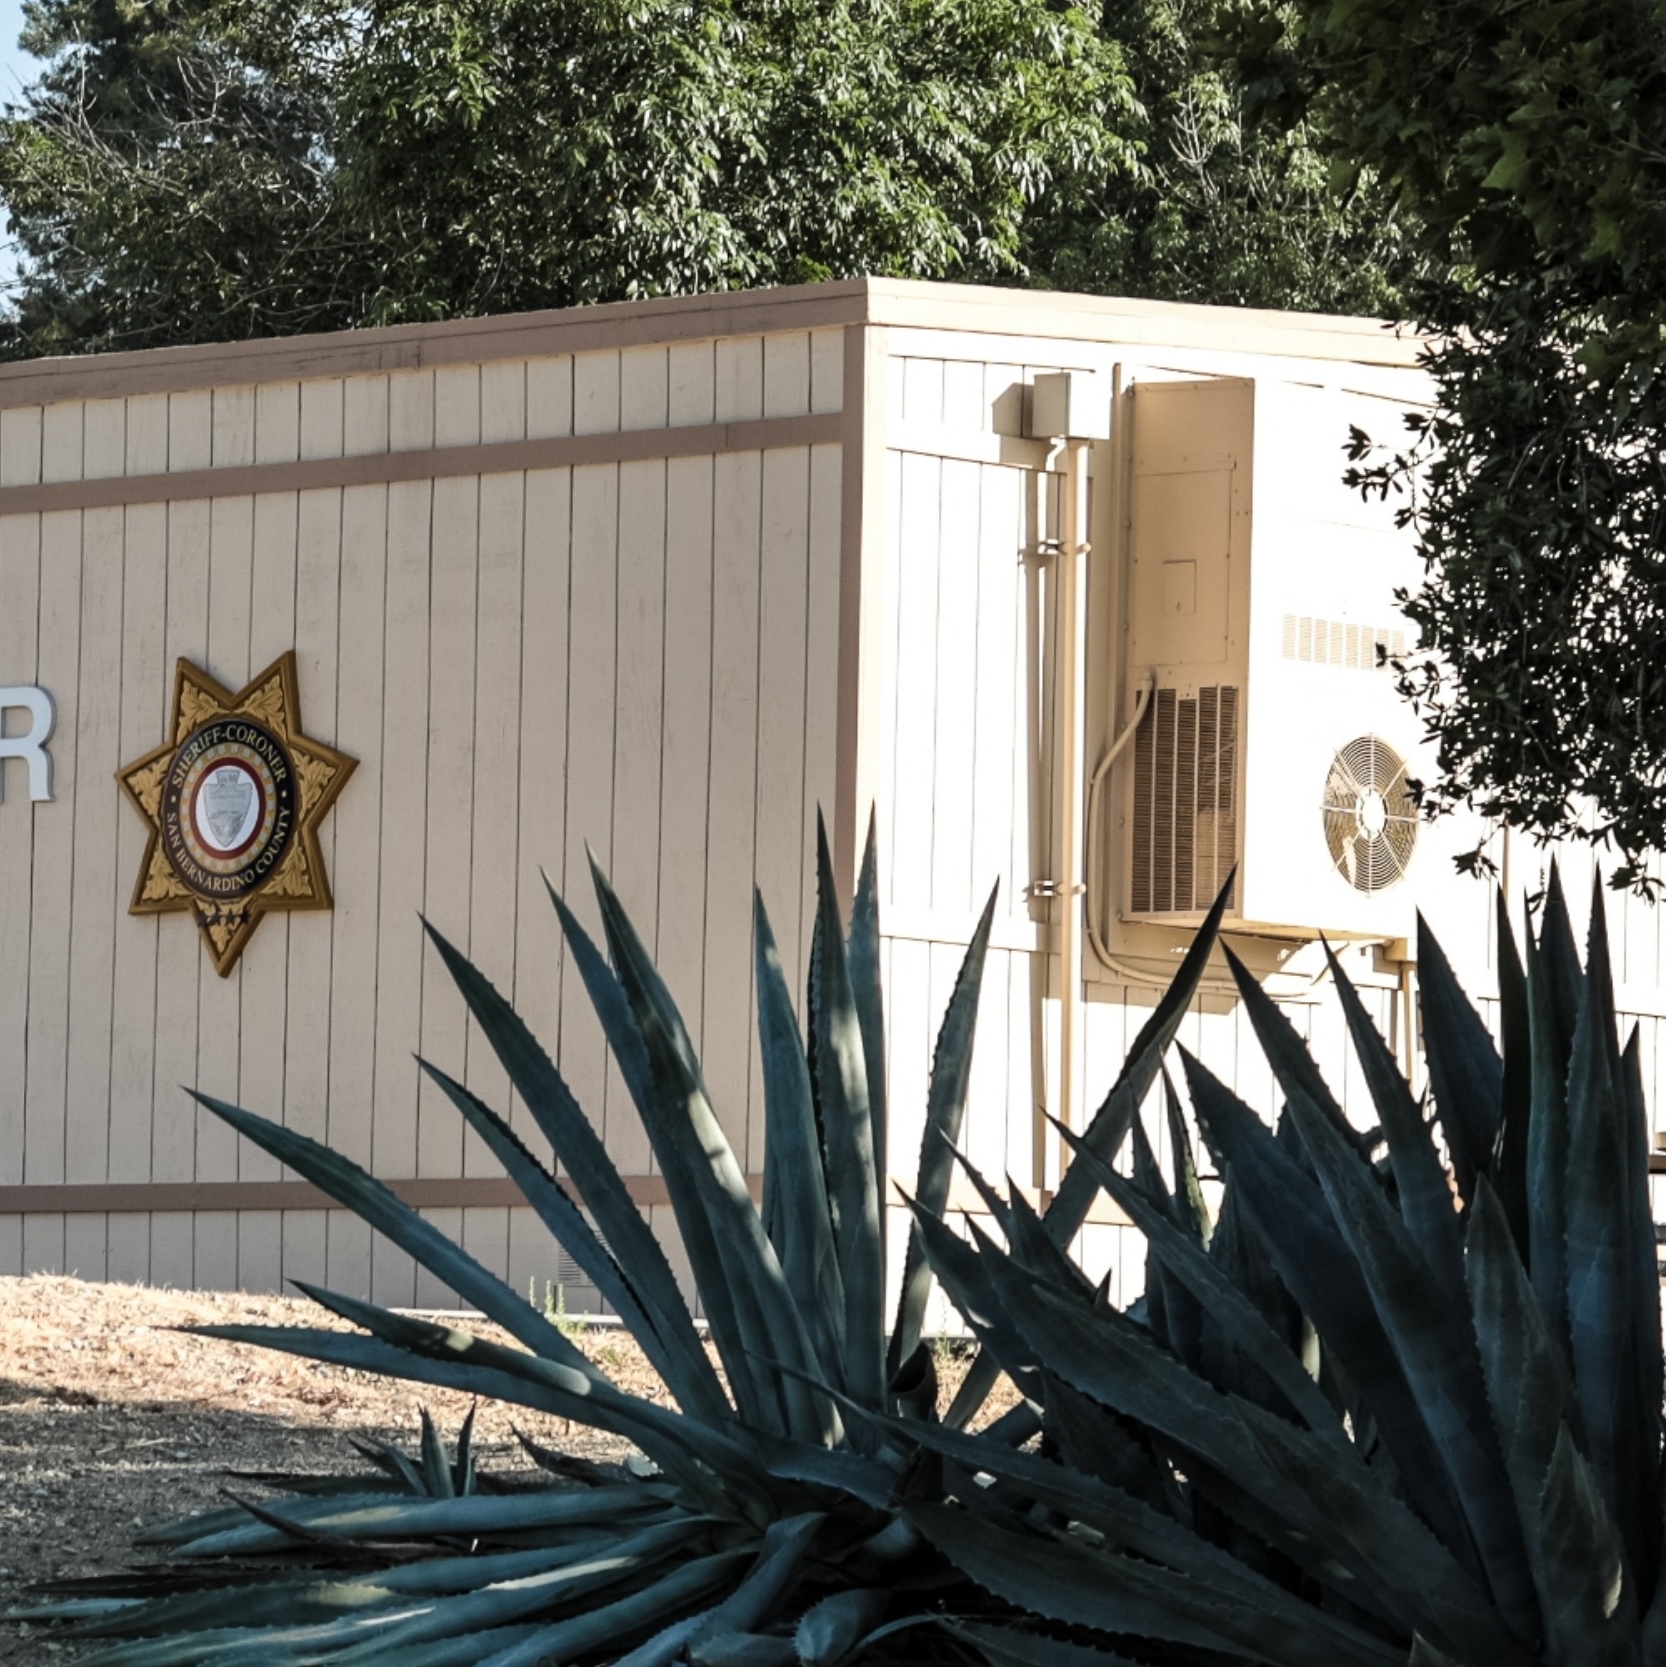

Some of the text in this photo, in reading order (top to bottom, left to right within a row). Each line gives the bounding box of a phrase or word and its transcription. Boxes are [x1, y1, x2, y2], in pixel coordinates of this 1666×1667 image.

[172, 724, 287, 788] SHERIFF-CORONER
[167, 807, 290, 892] SAN BERNARDINO COUNTY
